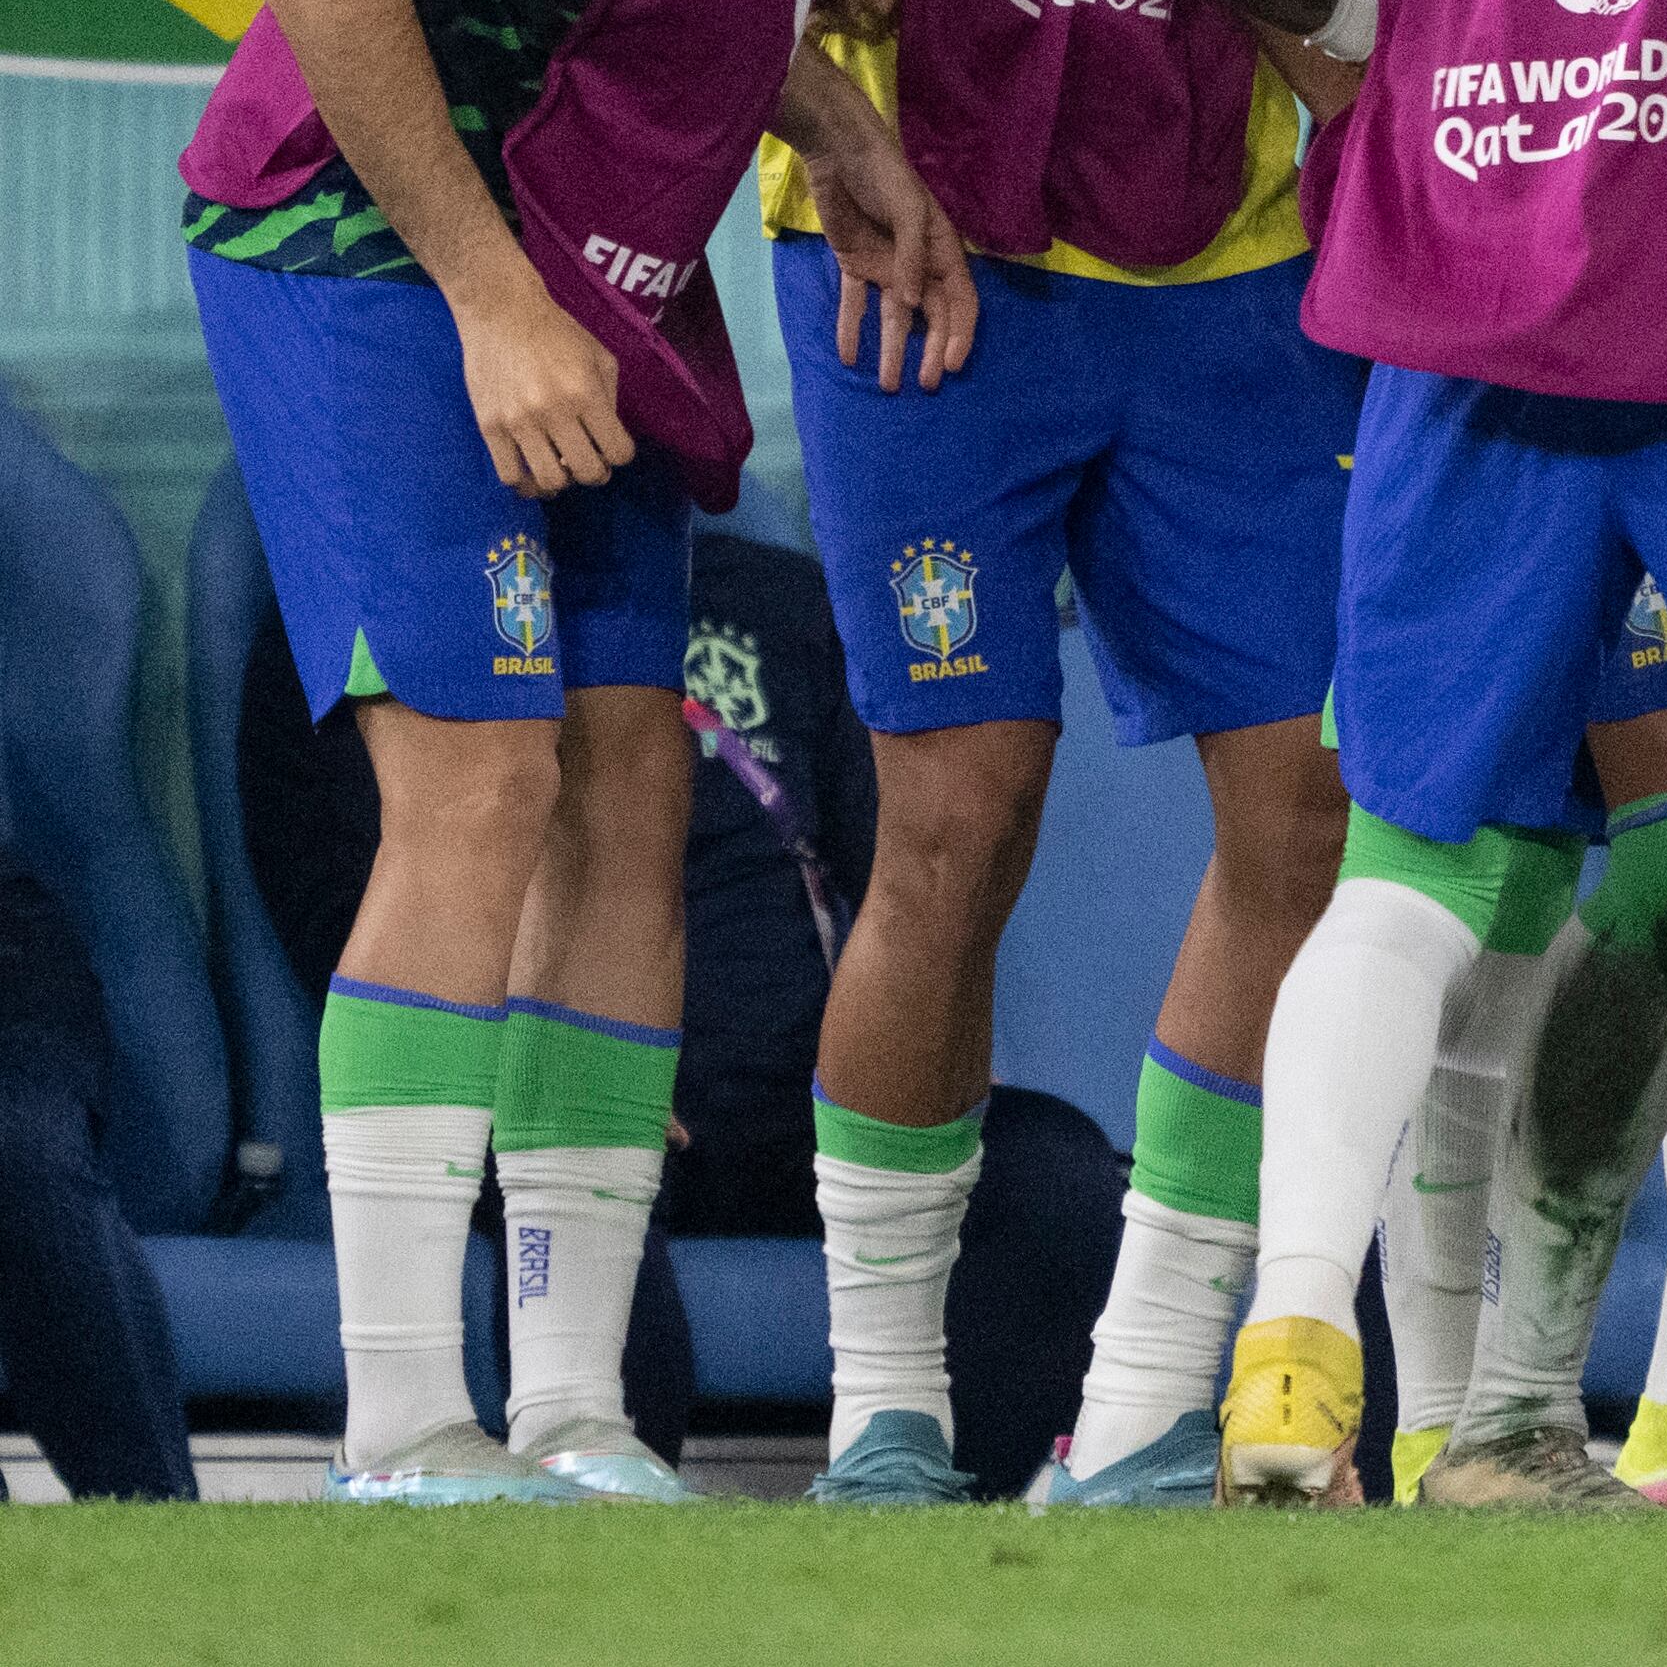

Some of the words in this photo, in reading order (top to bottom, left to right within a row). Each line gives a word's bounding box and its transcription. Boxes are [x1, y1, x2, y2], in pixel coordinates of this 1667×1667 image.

[1431, 63, 1506, 111] FIFA
[921, 595, 950, 610] CBF
[493, 657, 556, 675] BRASIL
[908, 654, 988, 683] BRASIL
[518, 1227, 552, 1309] BRASIL
